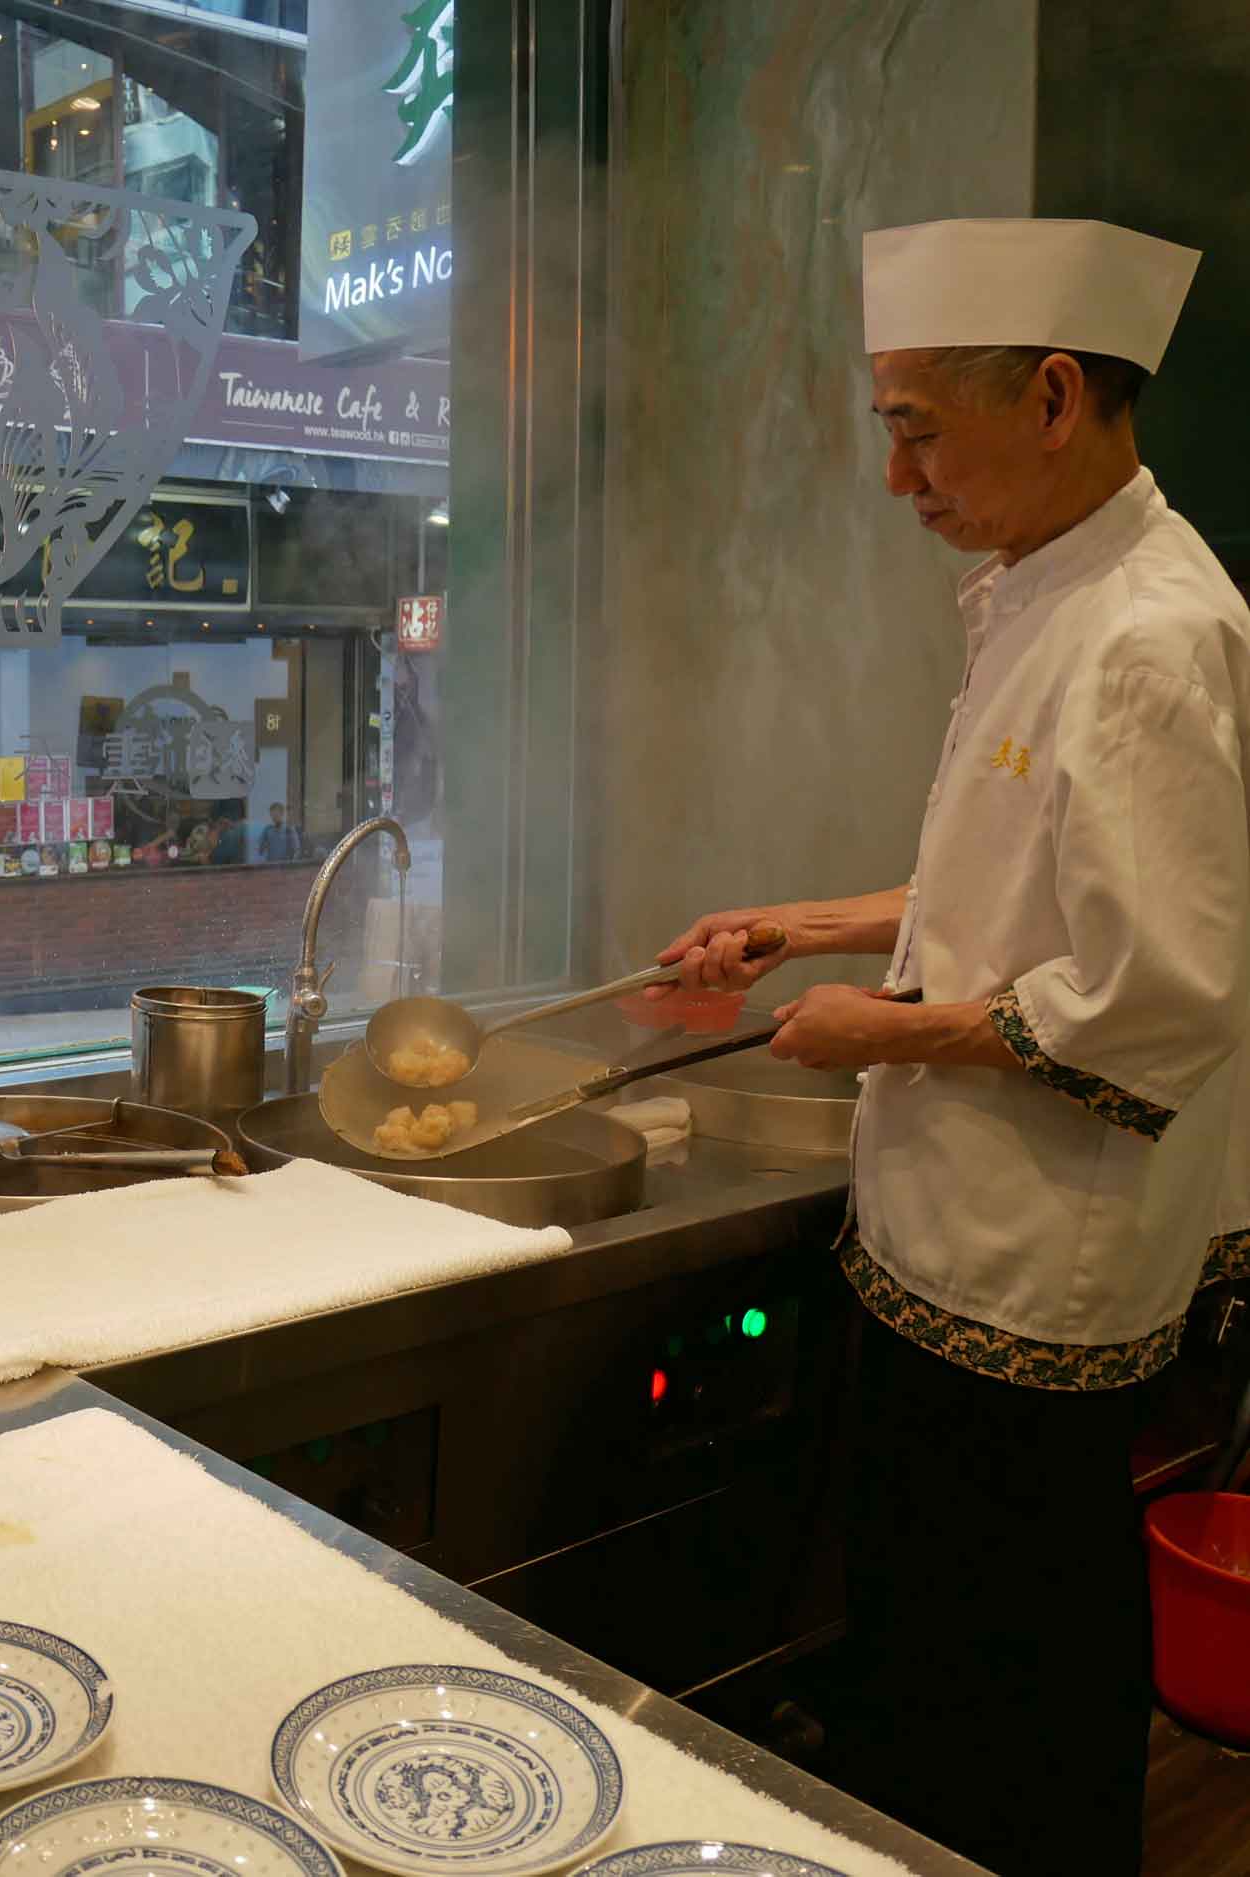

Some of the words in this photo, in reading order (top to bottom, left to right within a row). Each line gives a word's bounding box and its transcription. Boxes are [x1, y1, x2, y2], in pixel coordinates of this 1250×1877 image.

[324, 257, 405, 314] Mak's
[219, 372, 324, 416] Taiwanese
[336, 383, 383, 431] Cafe
[405, 391, 420, 422] &
